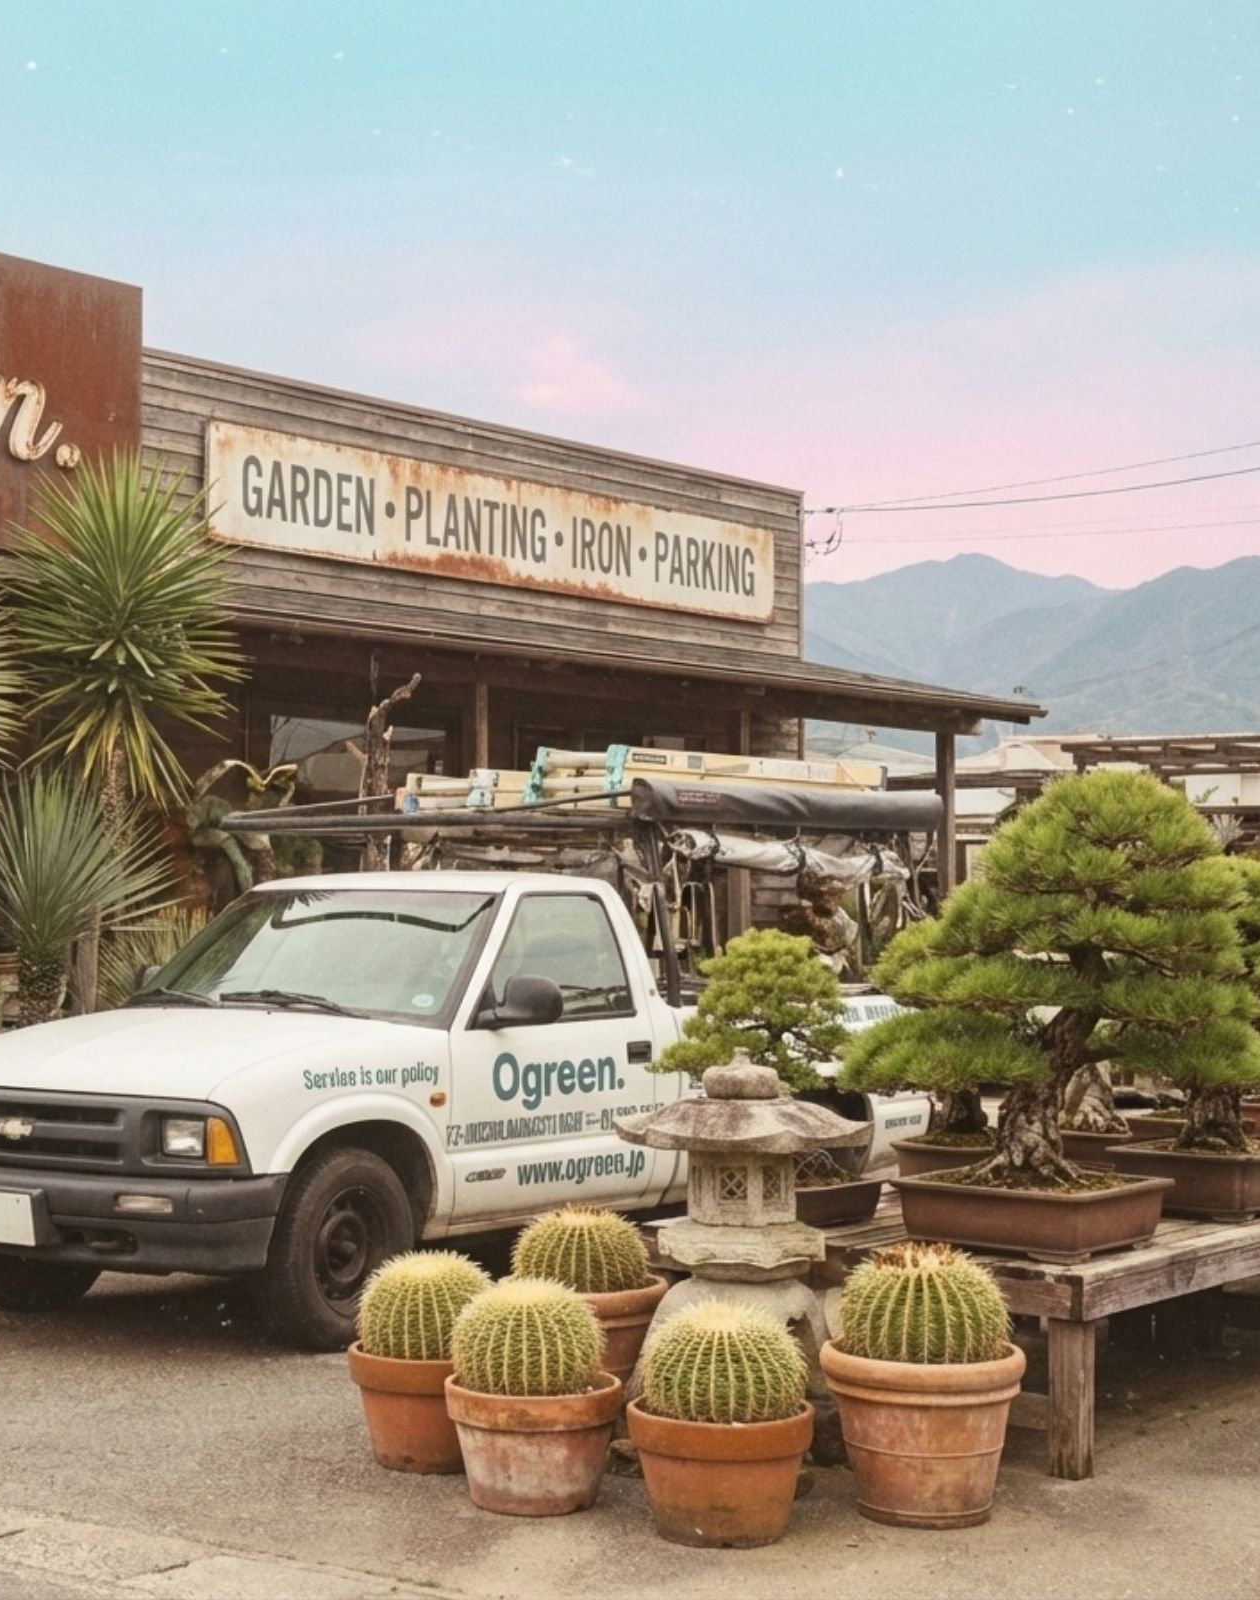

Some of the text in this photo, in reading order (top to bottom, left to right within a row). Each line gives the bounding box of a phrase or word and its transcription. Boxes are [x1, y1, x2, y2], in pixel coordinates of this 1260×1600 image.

[241, 454, 756, 597] GARDEN PLANTING IRON PARKING
[360, 1065, 372, 1086] is
[492, 1052, 626, 1110] Ogreen.
